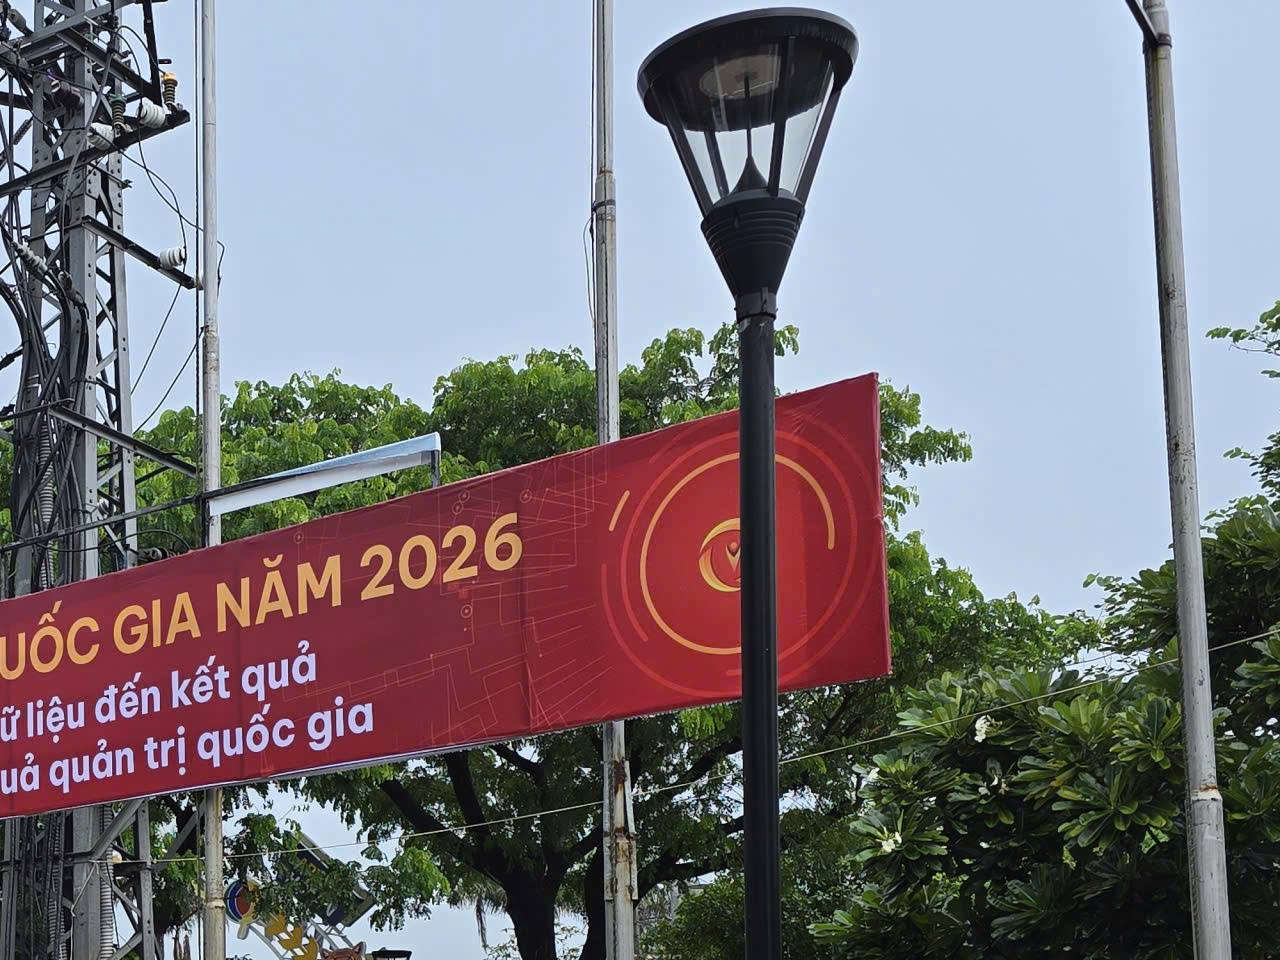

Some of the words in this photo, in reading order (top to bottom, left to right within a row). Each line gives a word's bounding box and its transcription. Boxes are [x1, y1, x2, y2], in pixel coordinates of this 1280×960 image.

[114, 592, 201, 655] GIA
[216, 554, 342, 633] NĂM
[360, 512, 523, 600] 2026
[27, 696, 85, 743] liệu
[94, 671, 161, 724] đến
[172, 655, 231, 709] kết
[241, 640, 316, 701] quả
[49, 738, 135, 794] quản
[143, 725, 186, 776] trị
[197, 703, 295, 768] quốc
[307, 695, 374, 751] gia
